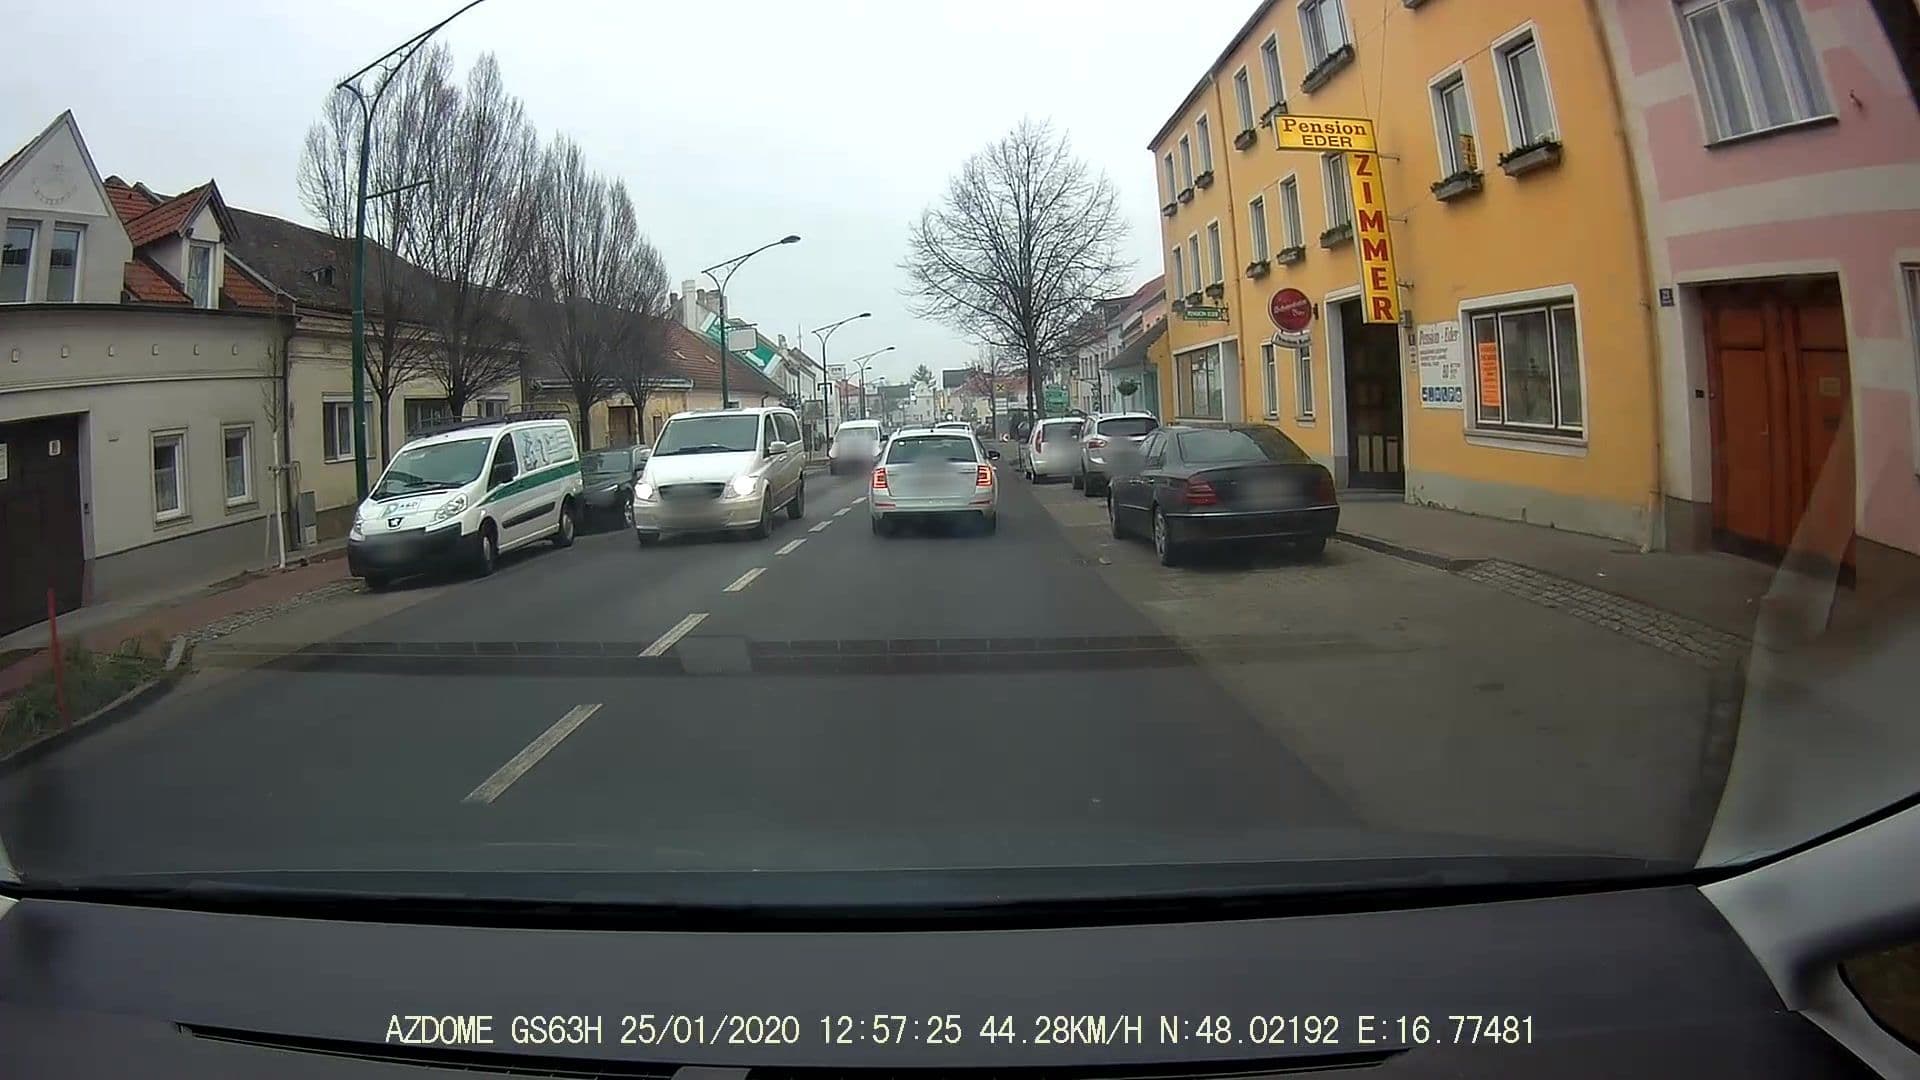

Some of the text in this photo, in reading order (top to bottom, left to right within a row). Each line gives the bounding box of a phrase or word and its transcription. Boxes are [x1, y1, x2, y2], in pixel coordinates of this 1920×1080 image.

[1282, 118, 1367, 136] Pension
[1302, 133, 1353, 148] EDER
[1356, 154, 1393, 321] ZIMMER
